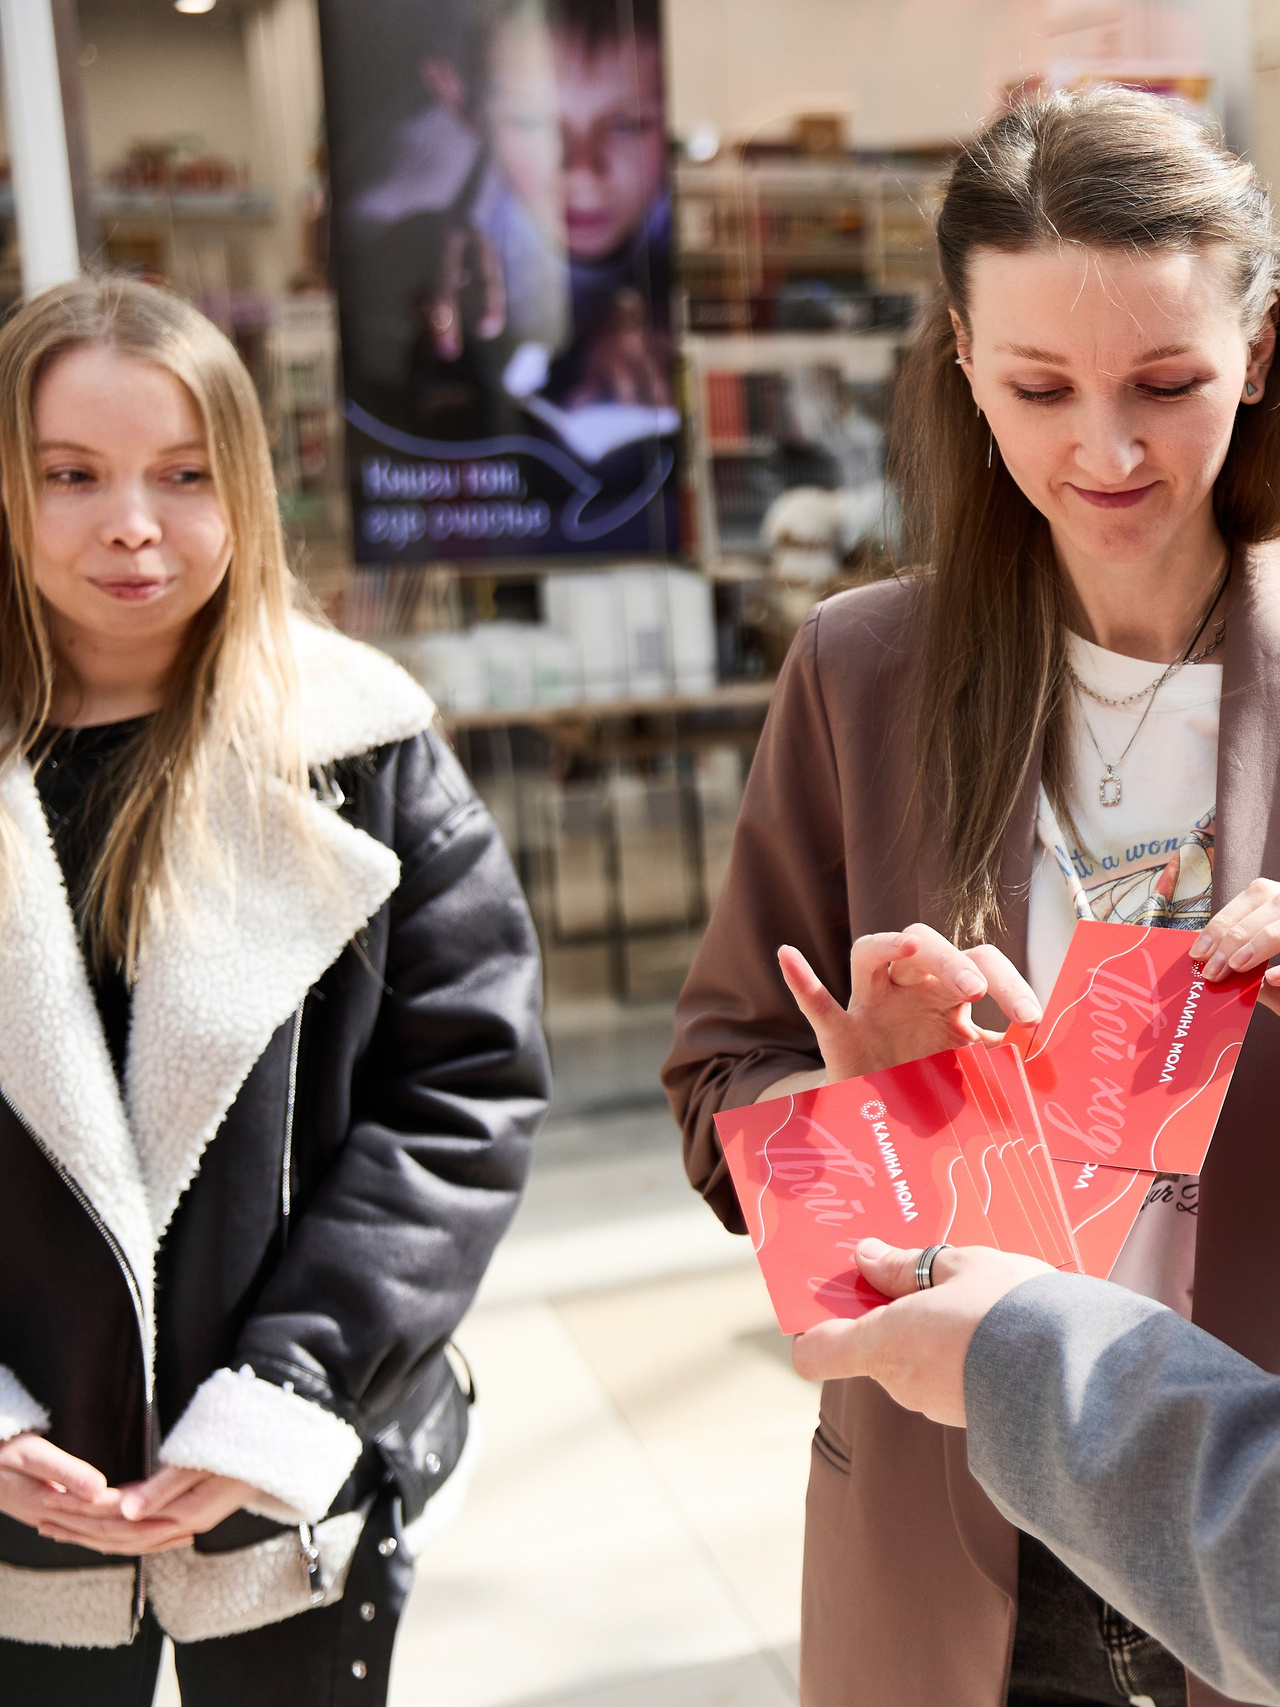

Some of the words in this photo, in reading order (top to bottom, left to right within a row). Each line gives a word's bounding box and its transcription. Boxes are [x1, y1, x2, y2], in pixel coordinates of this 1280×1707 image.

[1086, 948, 1168, 1064] Твой
[1174, 981, 1205, 1039] КАЛИНА
[1159, 1042, 1185, 1083] МОЛЛ
[1044, 1077, 1127, 1160] ход
[756, 1116, 876, 1227] Твой
[872, 1121, 904, 1179] КАЛИНА
[893, 1180, 919, 1223] МОЛЛ
[1073, 1162, 1099, 1190] ОЛЛ
